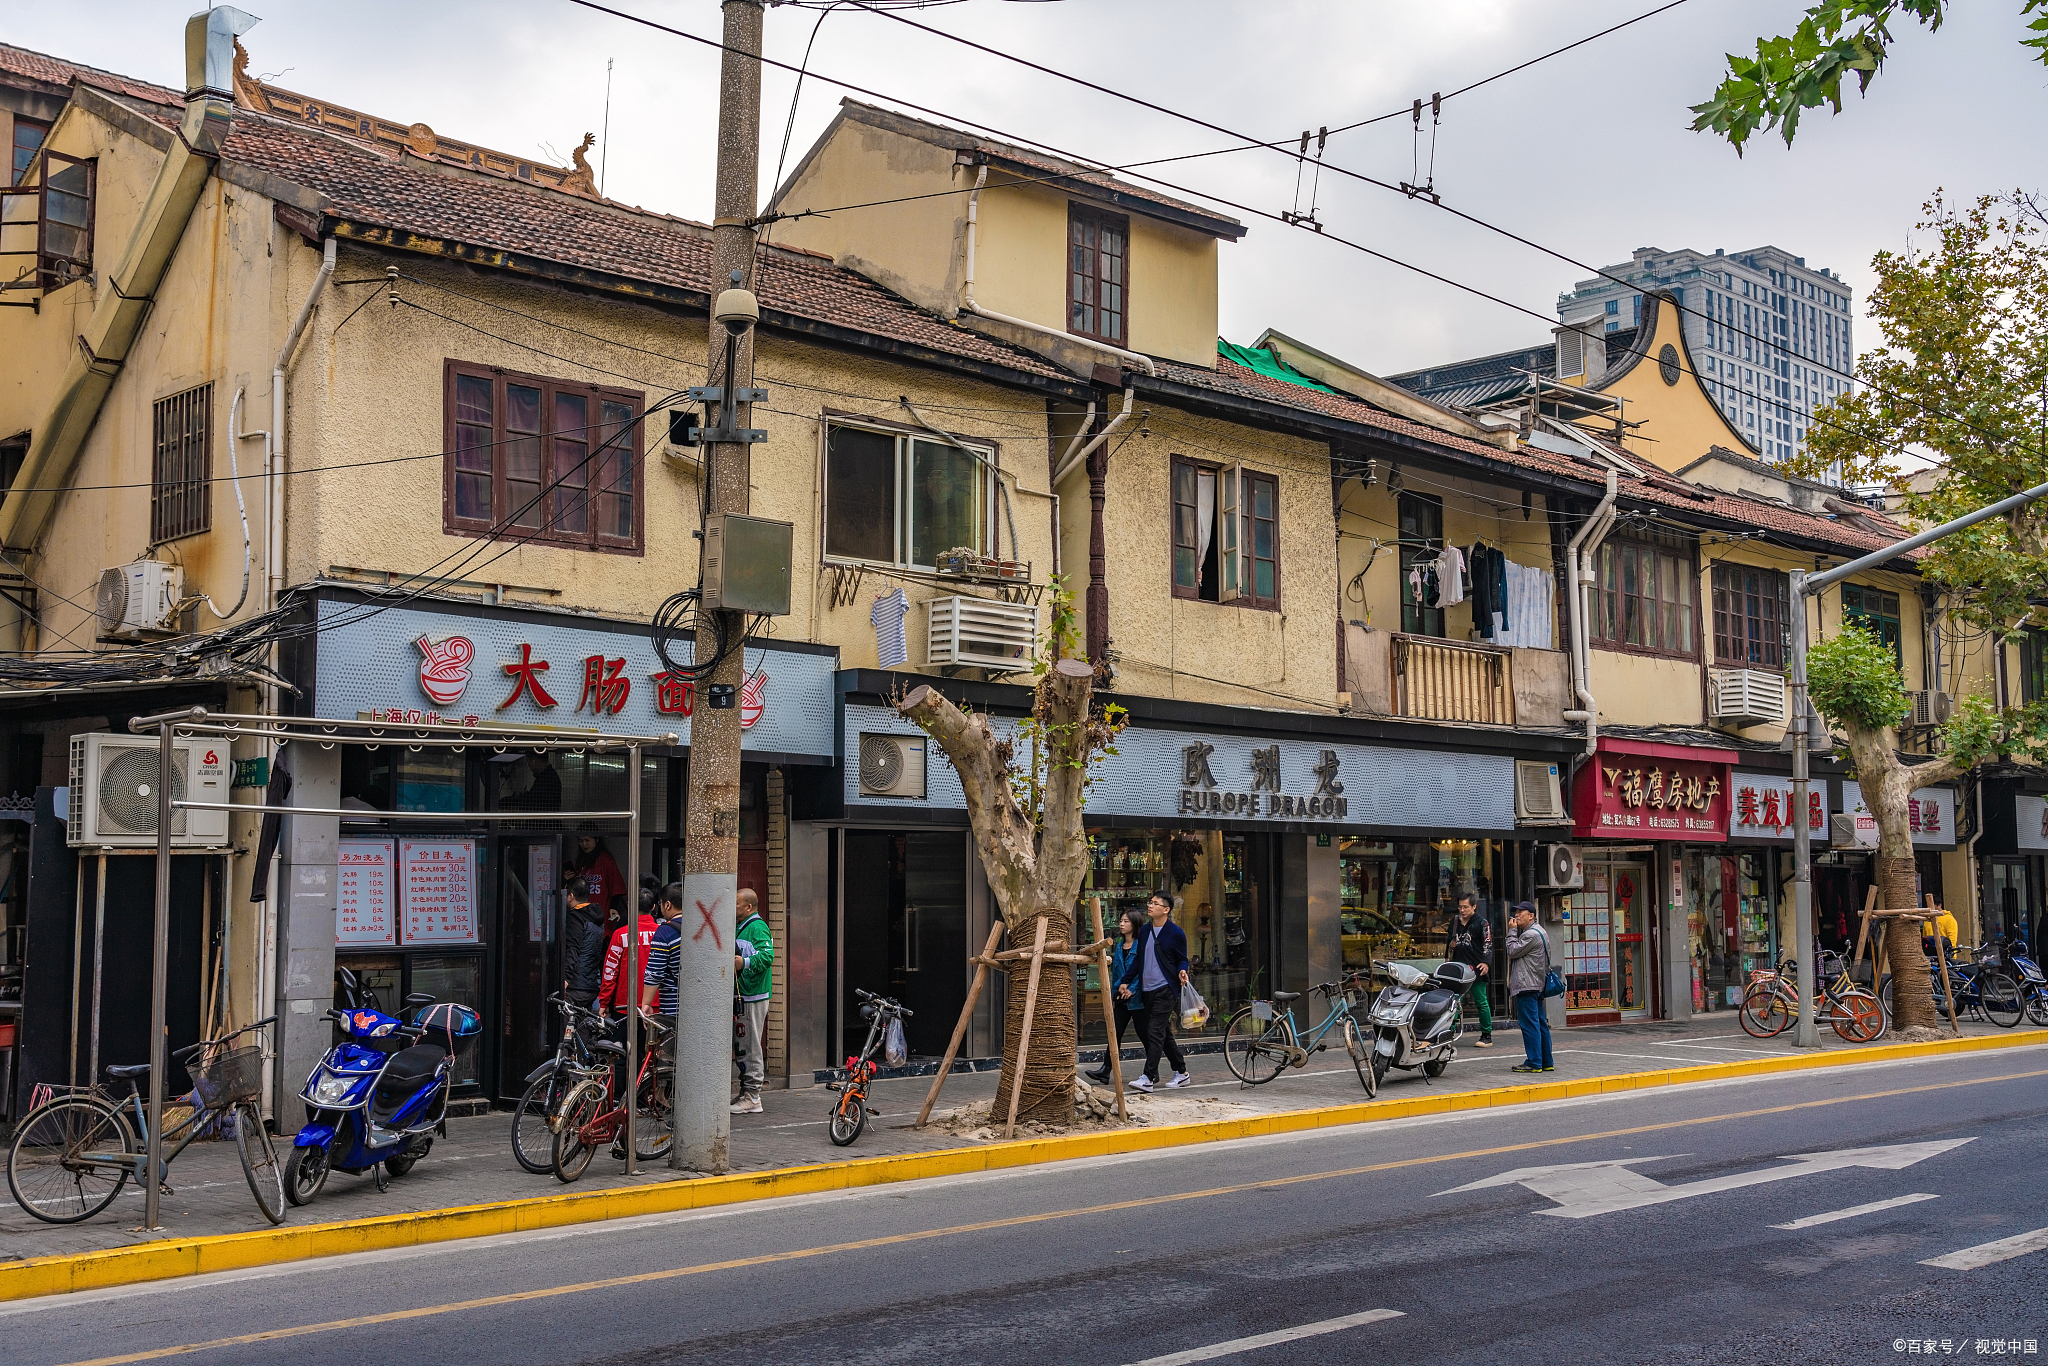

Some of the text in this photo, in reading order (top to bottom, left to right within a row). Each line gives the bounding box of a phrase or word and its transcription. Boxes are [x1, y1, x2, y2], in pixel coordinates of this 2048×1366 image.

[496, 643, 694, 717] 大肠面
[721, 696, 727, 706] 9
[371, 708, 480, 727] 上海仅此一家
[1181, 740, 1345, 795] 欧洲龙
[1618, 766, 1721, 814] 福鹰房地产
[1178, 789, 1348, 818] EUROPE DRAGON
[418, 850, 454, 859] 价目表
[448, 863, 467, 873] 30元
[448, 873, 467, 883] 20元
[448, 883, 468, 893] 30元
[589, 884, 601, 895] 25
[449, 893, 468, 903] 20元
[452, 905, 468, 913] 15元
[453, 915, 469, 923] 15元
